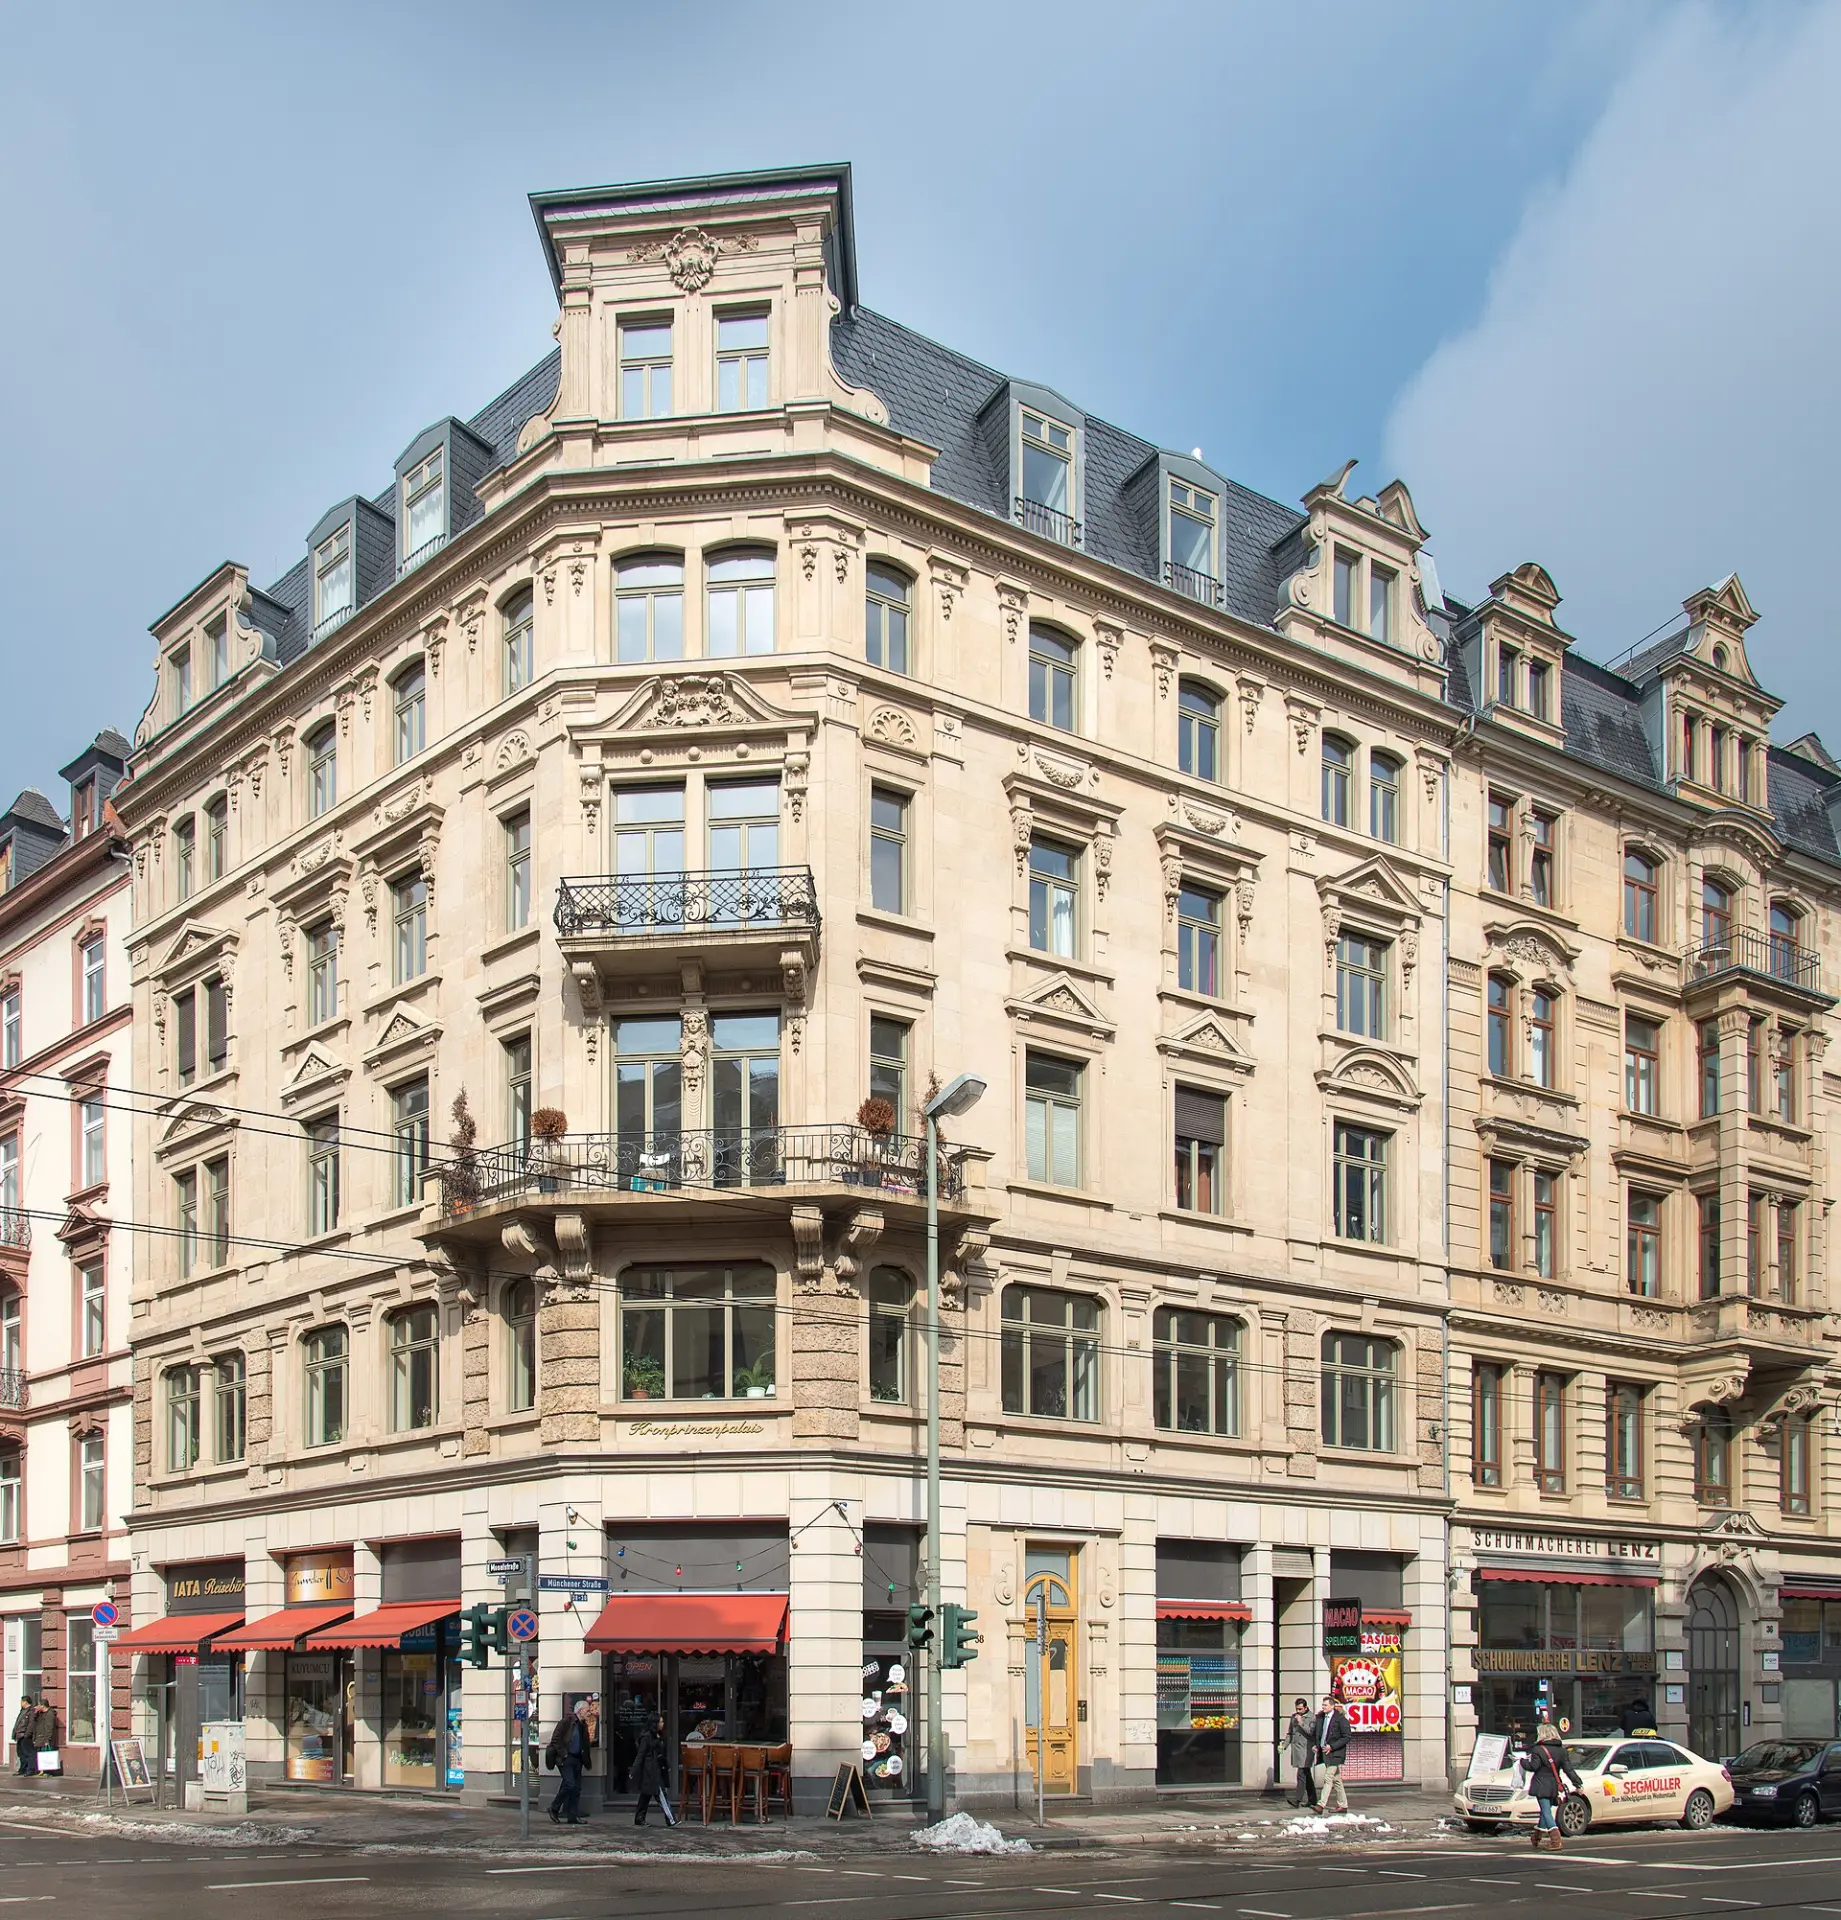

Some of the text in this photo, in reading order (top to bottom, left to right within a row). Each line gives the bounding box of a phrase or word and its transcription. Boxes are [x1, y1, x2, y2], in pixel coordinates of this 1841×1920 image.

[628, 1420, 764, 1440] Kronprinzenpalais
[1474, 1531, 1654, 1558] SCHUHMACHEREI LENZ
[173, 1579, 201, 1598] IATA
[547, 1578, 602, 1589] Münchener Straße
[1325, 1607, 1359, 1627] MACAO
[1325, 1635, 1358, 1647] SPIELOTHEK
[291, 1663, 330, 1675] KUYUMCU
[625, 1661, 652, 1672] OPEN
[1474, 1651, 1571, 1672] SCHUHMACHEREI
[1576, 1652, 1623, 1672] LENZ
[1345, 1685, 1374, 1696] MACAO
[1623, 1777, 1681, 1795] SEGMÜLLER
